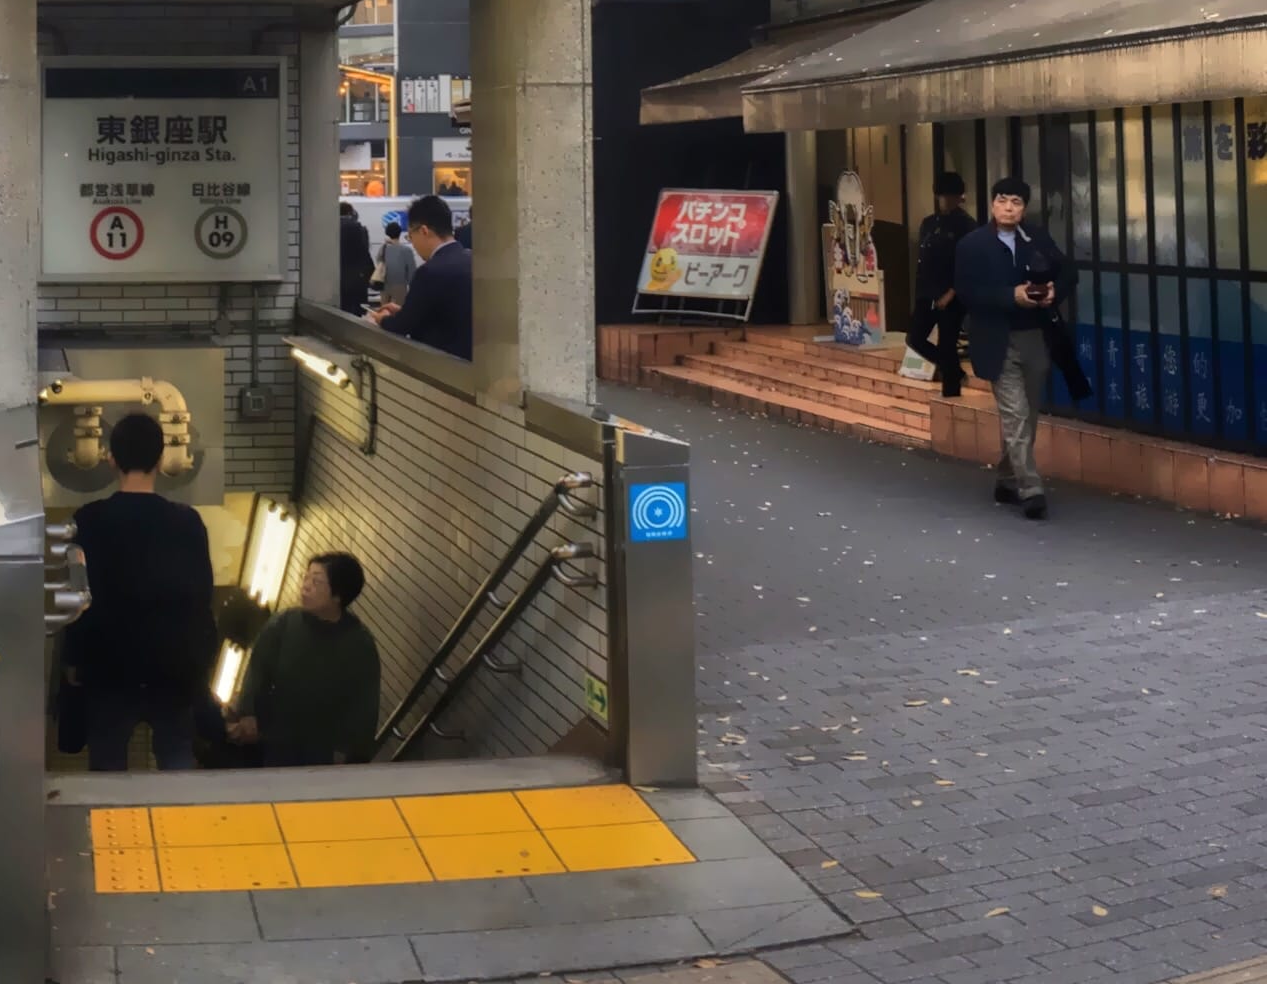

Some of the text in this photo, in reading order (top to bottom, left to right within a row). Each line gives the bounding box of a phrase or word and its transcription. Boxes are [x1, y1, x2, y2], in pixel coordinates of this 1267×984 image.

[96, 115, 228, 145] 東銀座駅
[88, 148, 236, 165] Higashi-ginza Sta.
[80, 183, 155, 198] 都営浅草線
[192, 183, 251, 198] 日比谷線
[110, 216, 124, 229] A
[214, 216, 228, 229] H
[106, 232, 127, 247] 11
[209, 232, 235, 247] 09
[672, 223, 741, 246] スロット
